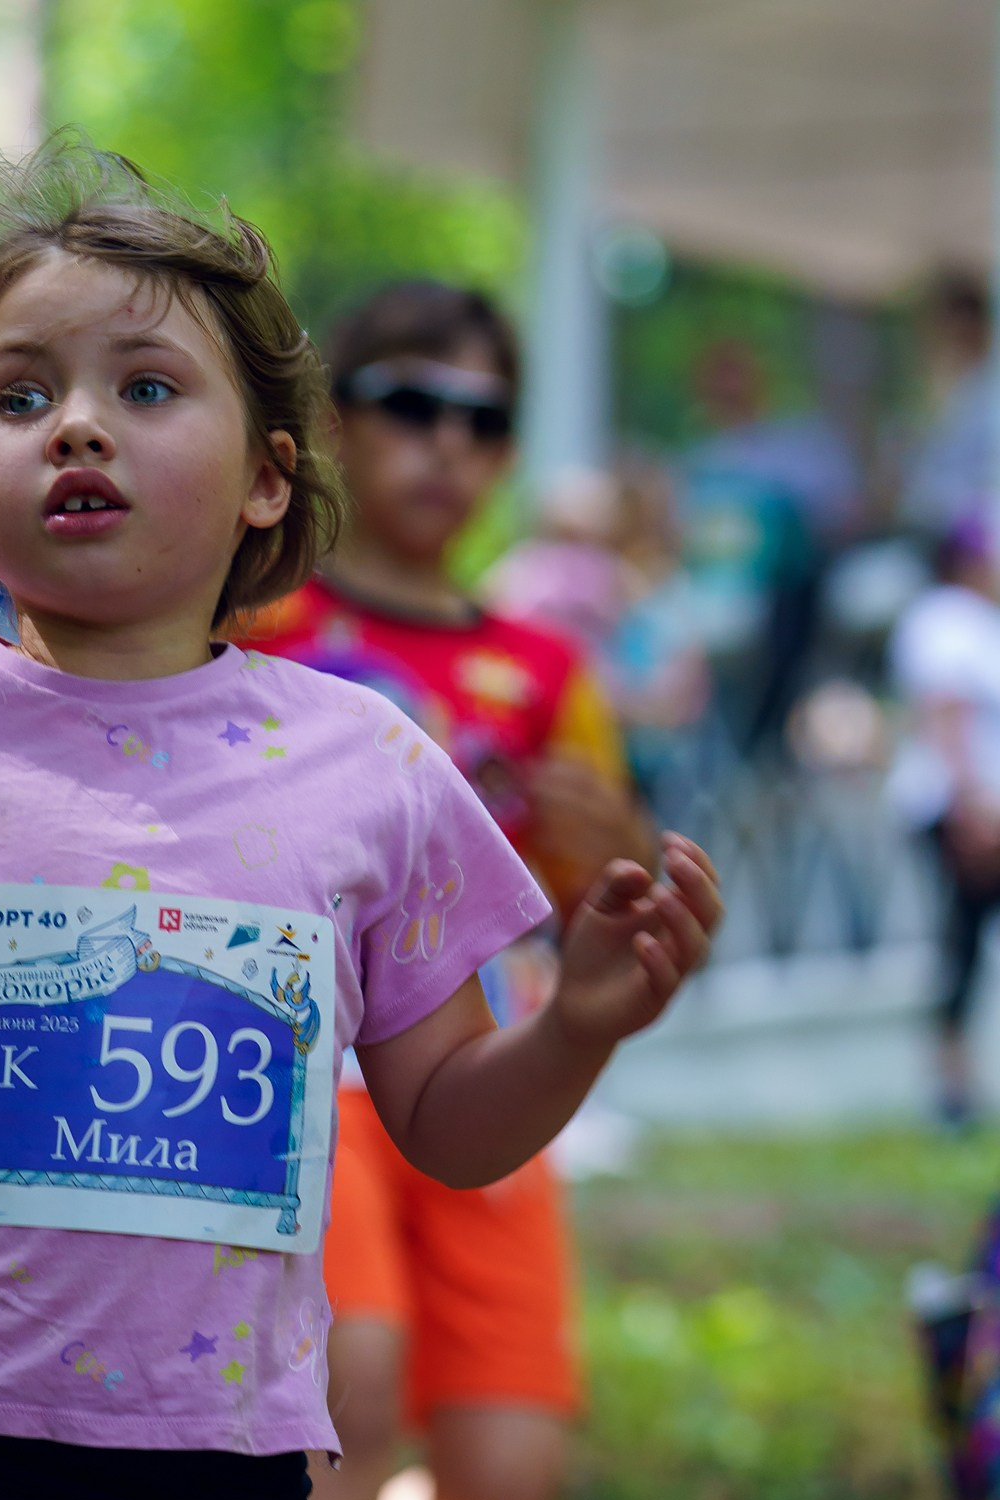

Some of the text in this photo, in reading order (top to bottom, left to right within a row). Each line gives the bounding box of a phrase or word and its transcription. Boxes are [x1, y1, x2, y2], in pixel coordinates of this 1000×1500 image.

[38, 910, 67, 929] 40
[40, 1014, 80, 1033] 2025
[89, 1015, 275, 1126] 593
[50, 1115, 199, 1172] Мила
